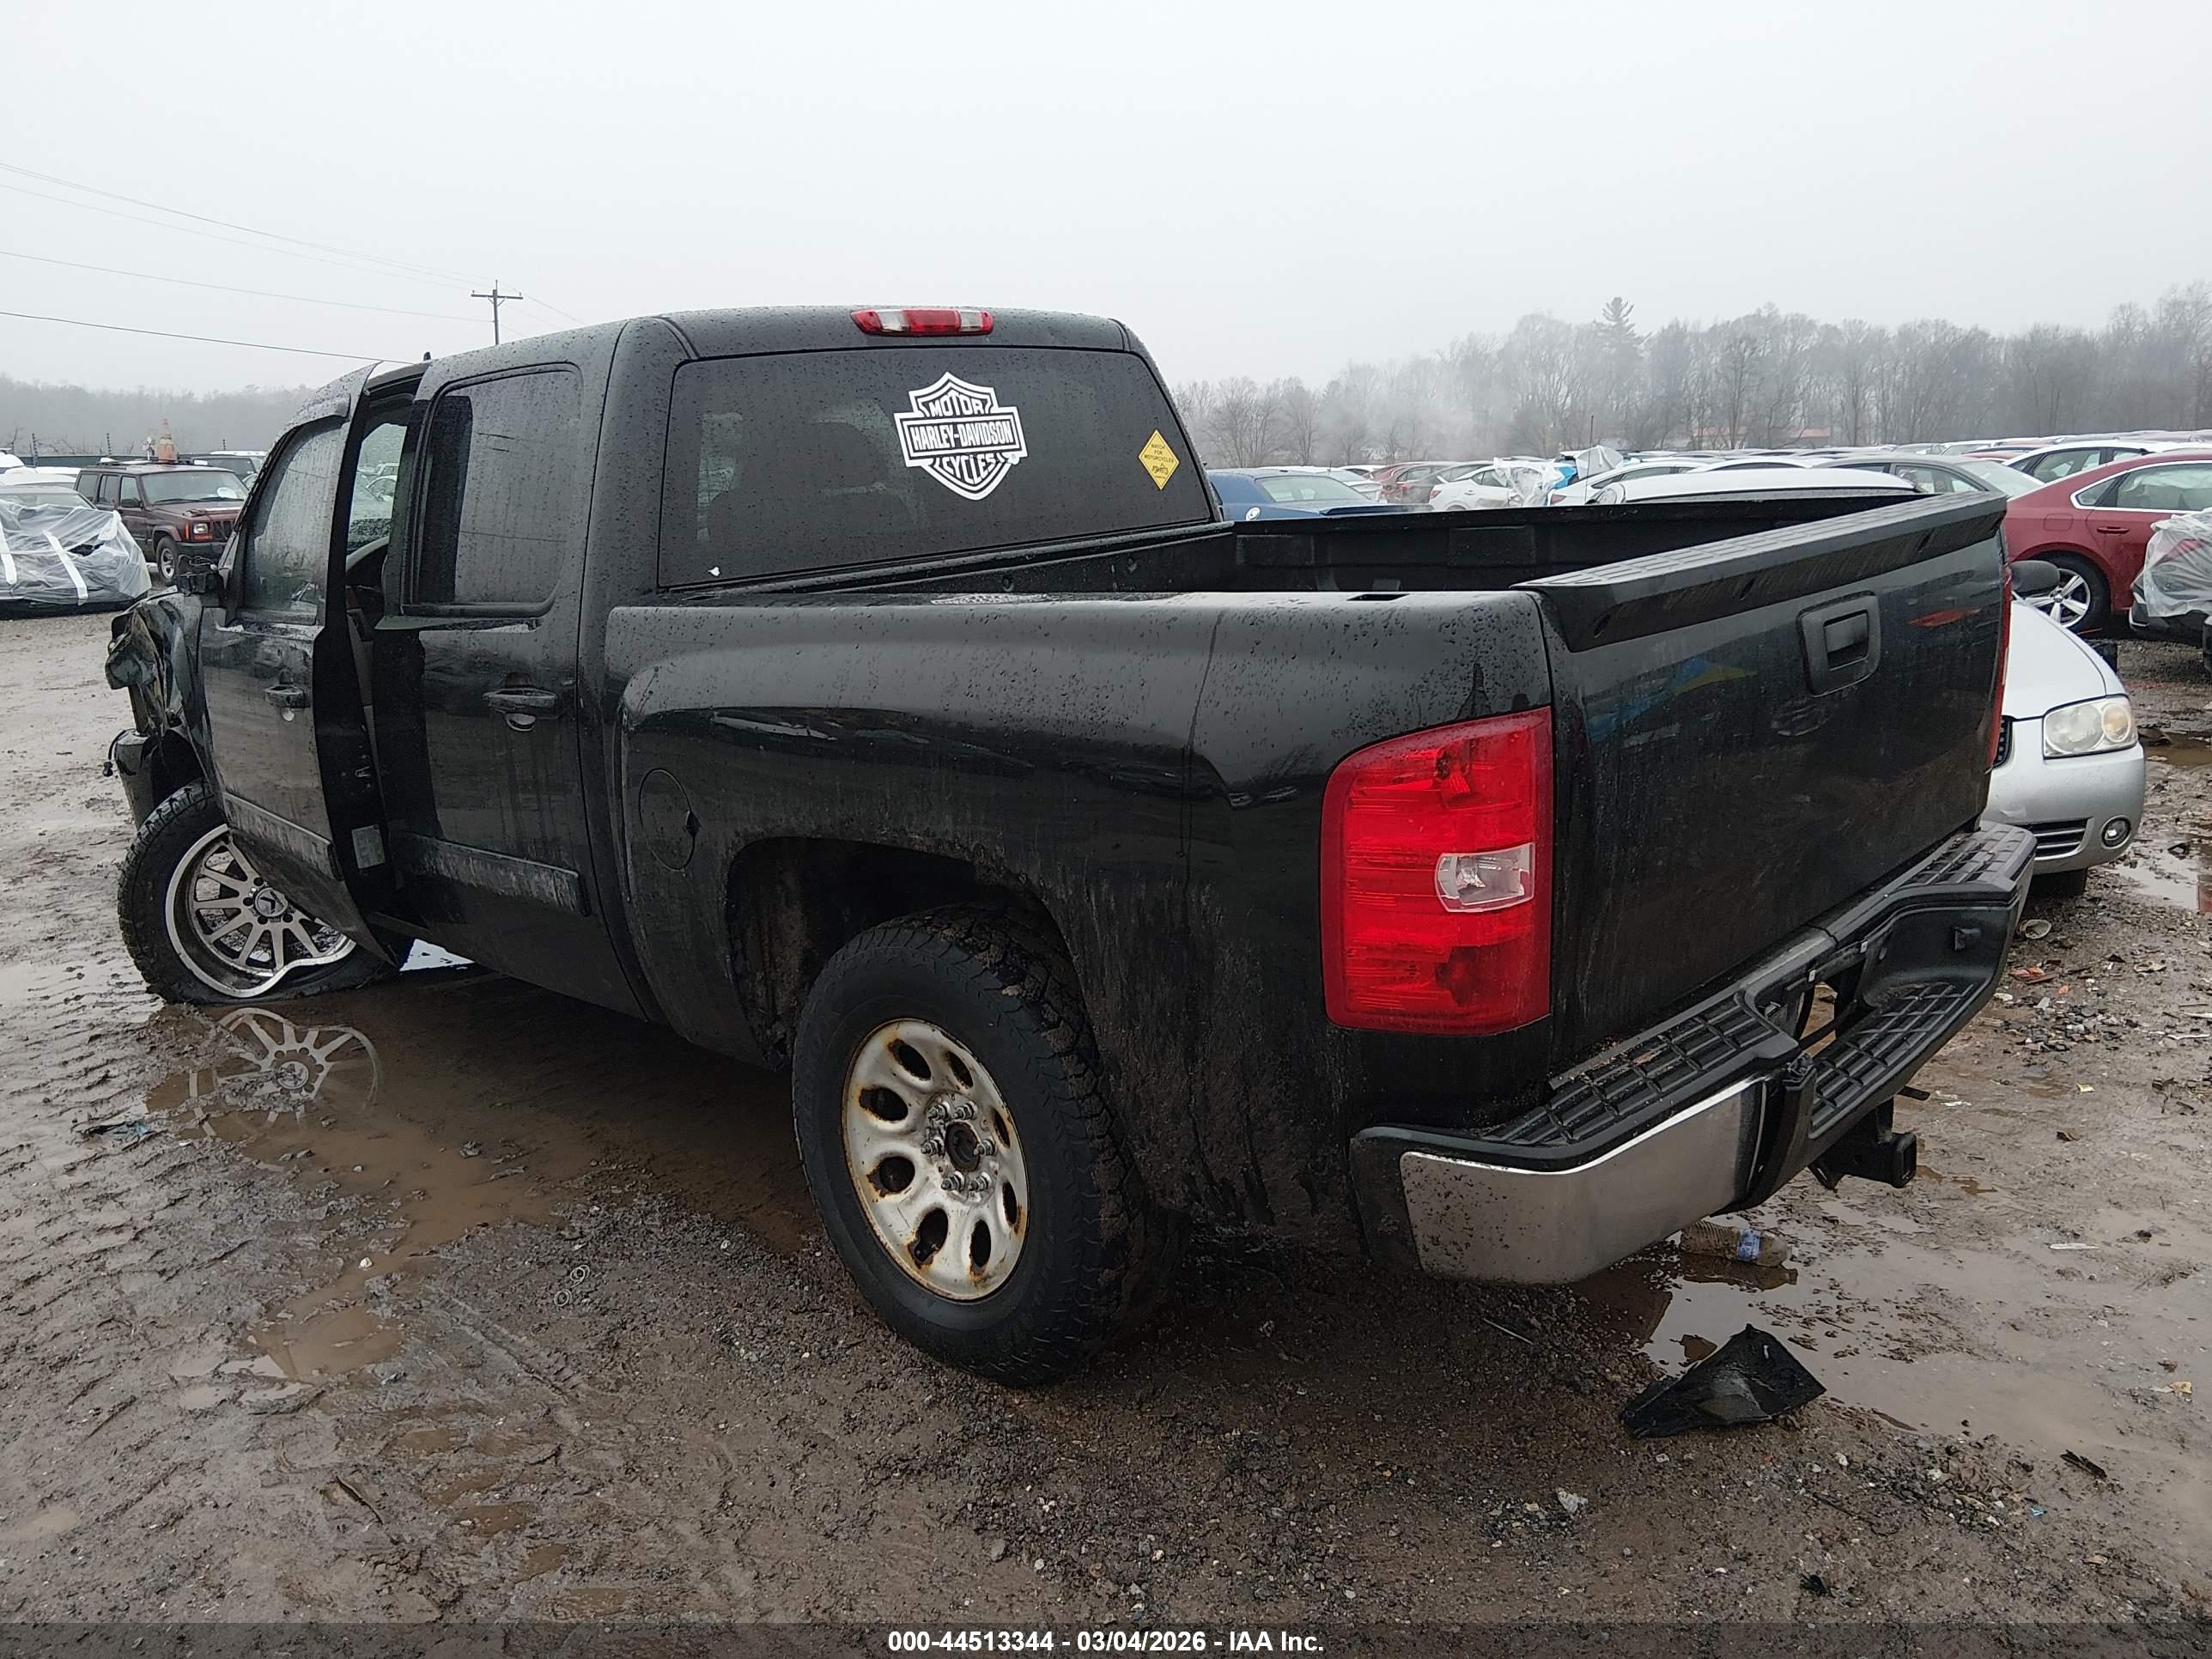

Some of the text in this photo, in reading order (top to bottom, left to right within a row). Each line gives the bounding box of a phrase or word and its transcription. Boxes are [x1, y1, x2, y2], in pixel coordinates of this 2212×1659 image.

[928, 388, 985, 417] MOTOR
[909, 420, 1014, 451] HARLEY-DAVIDSON
[942, 452, 996, 485] CYCLES
